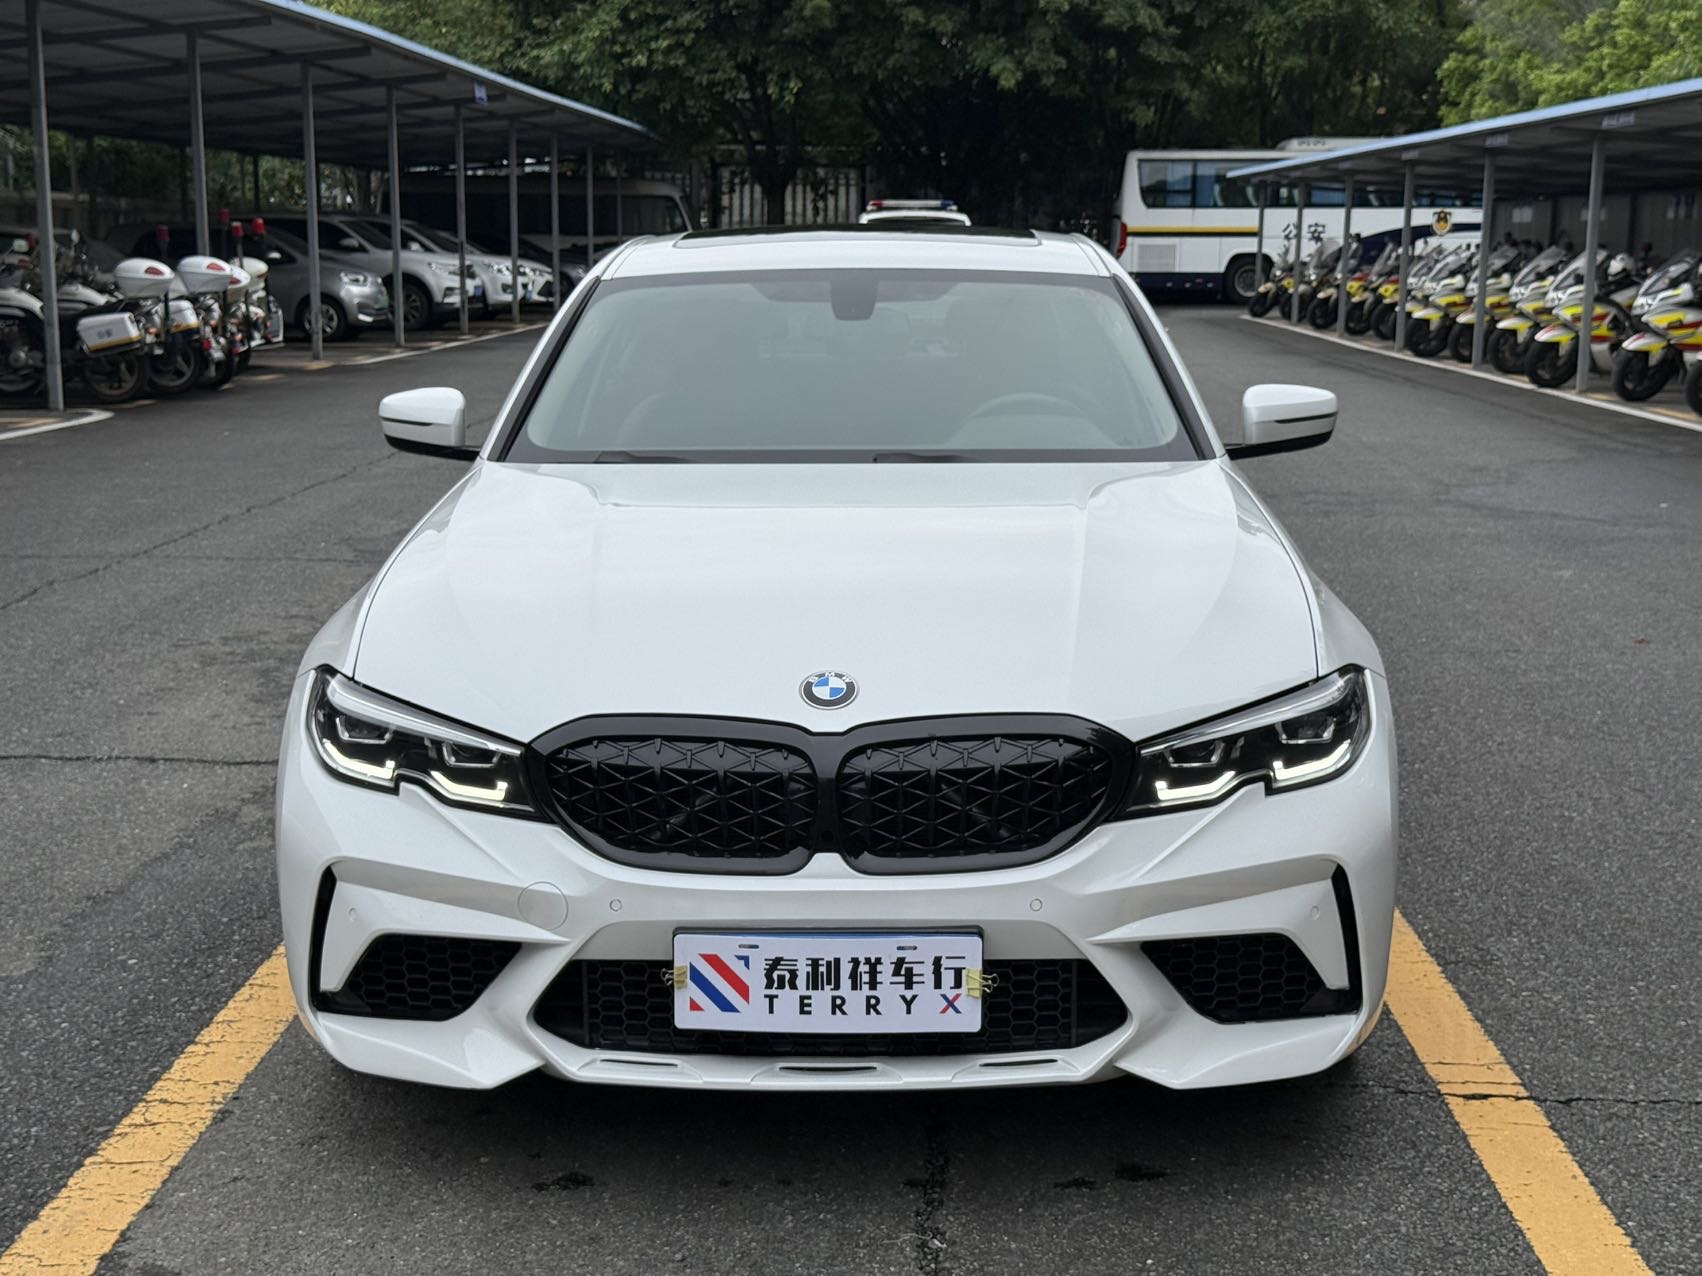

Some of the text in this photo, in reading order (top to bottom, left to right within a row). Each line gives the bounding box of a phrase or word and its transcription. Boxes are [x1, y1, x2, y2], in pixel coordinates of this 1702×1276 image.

[1281, 222, 1326, 245] 公安
[764, 956, 966, 991] 泰利祥车行
